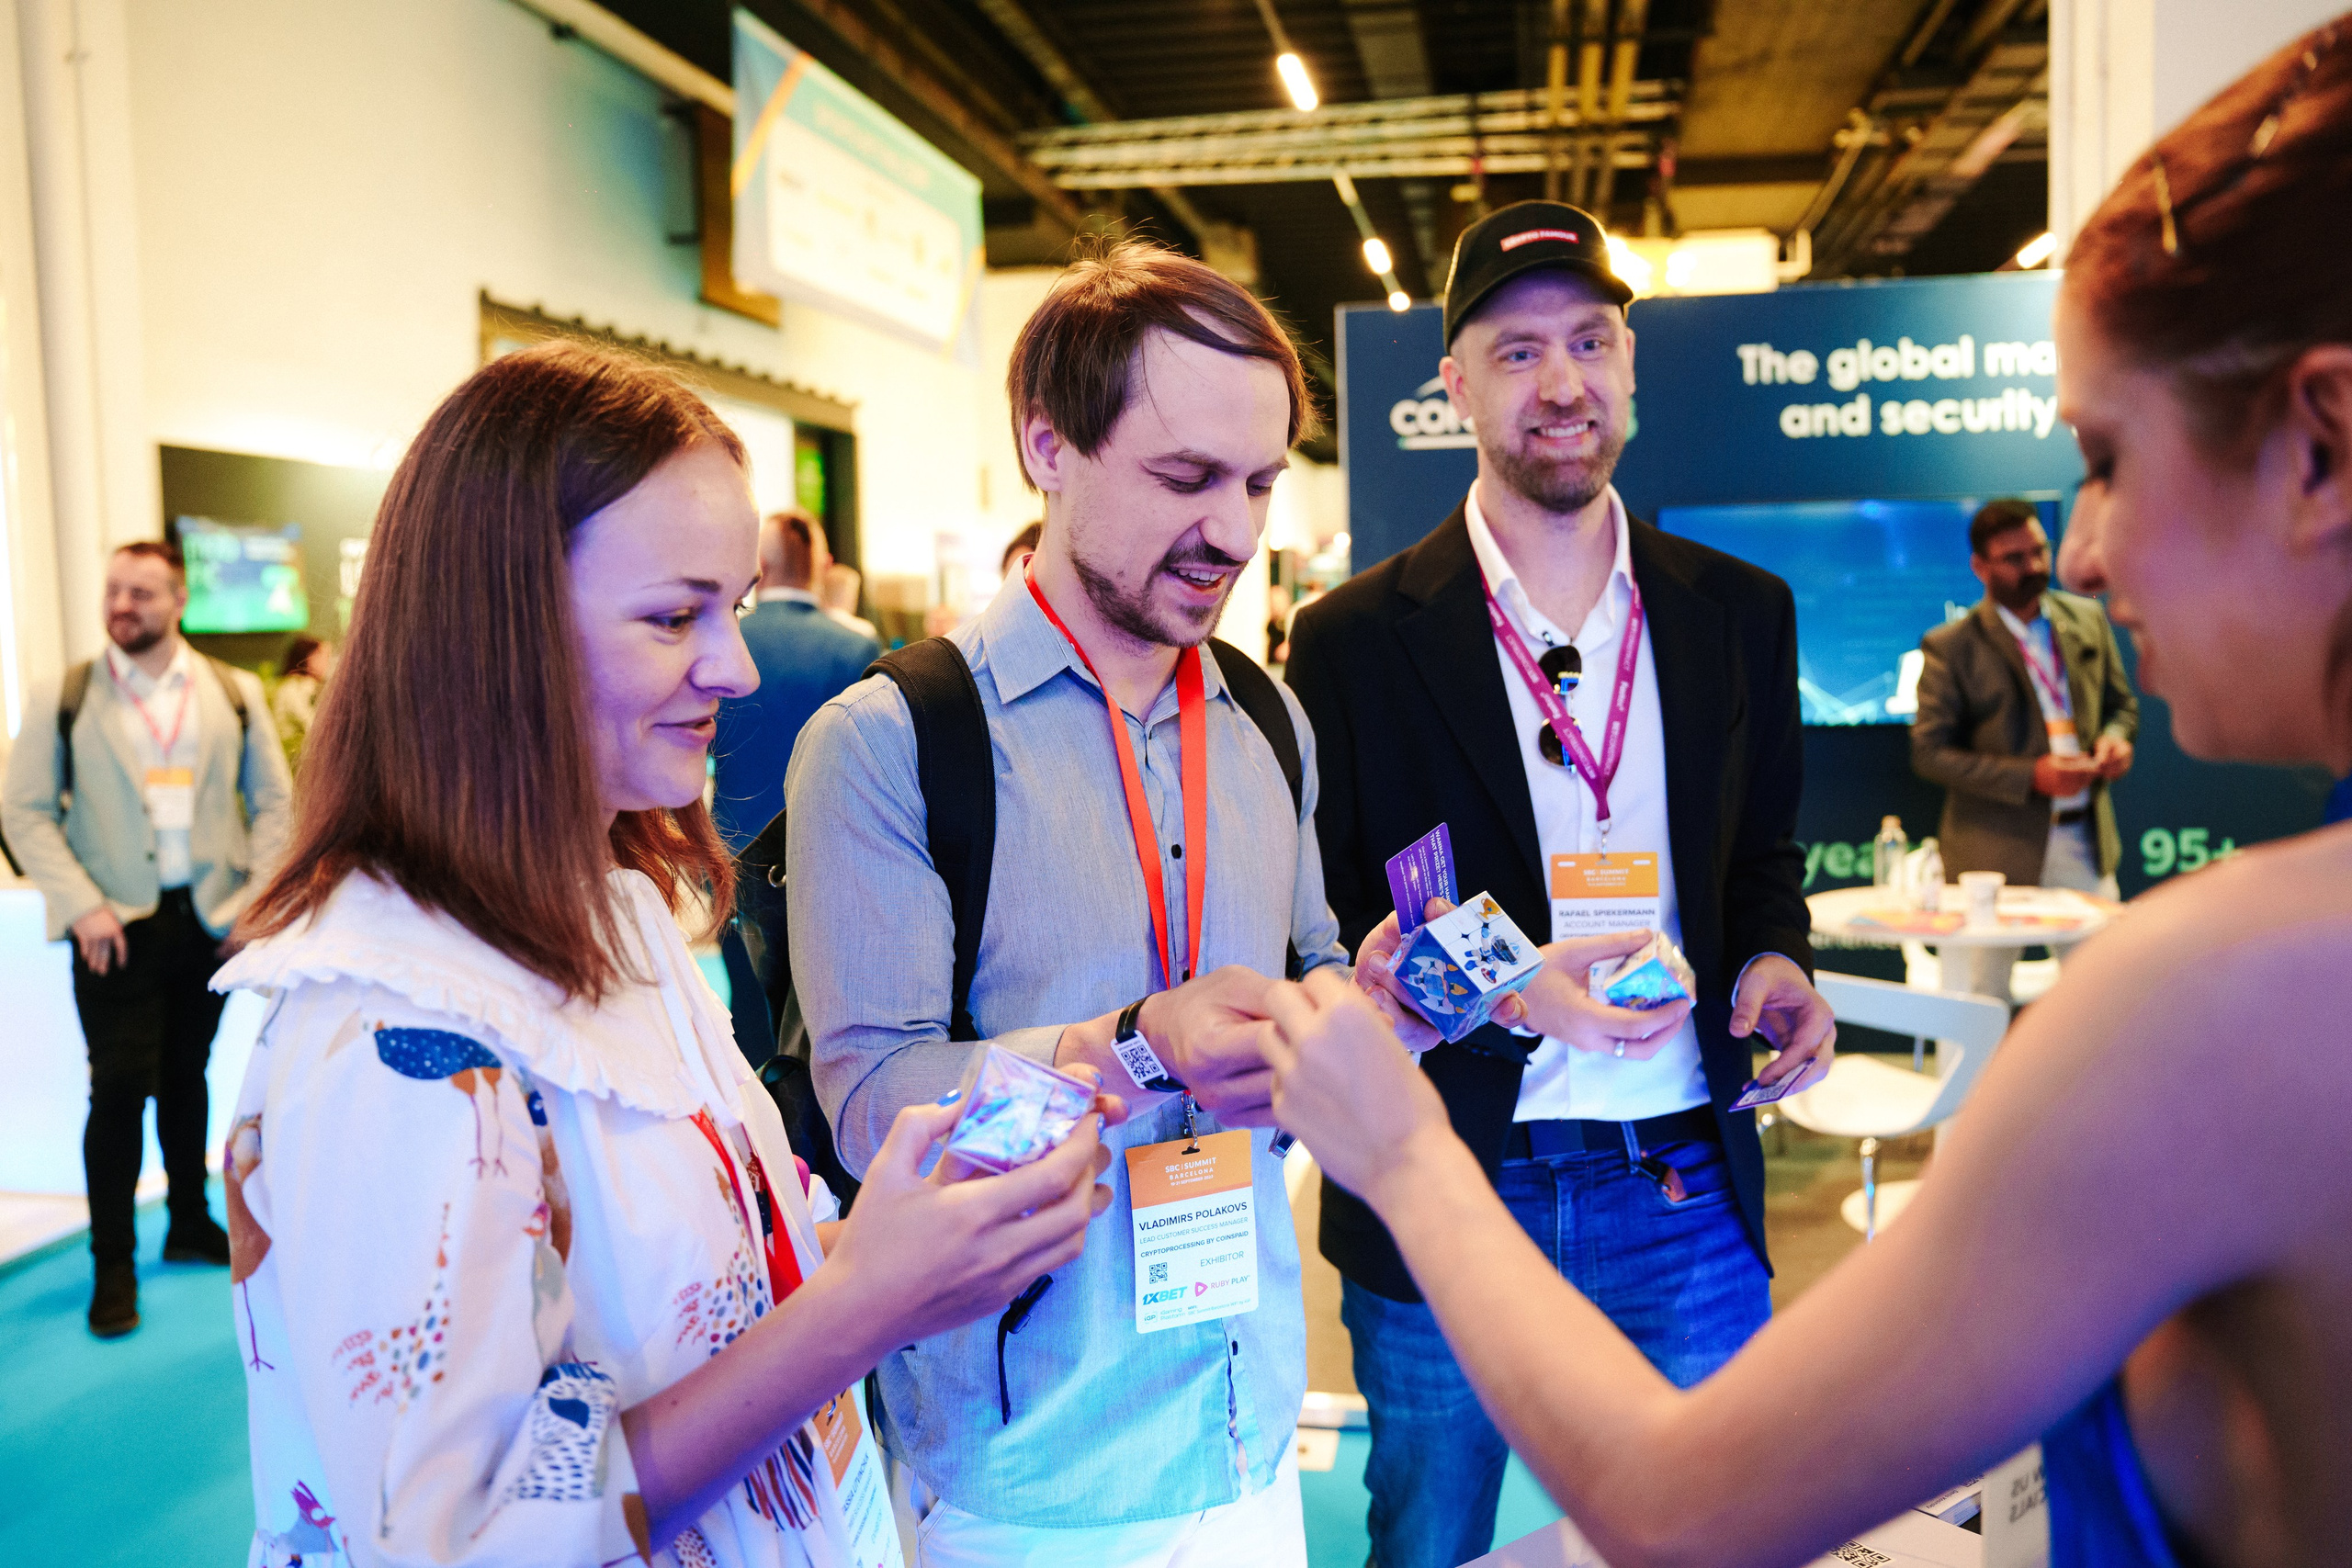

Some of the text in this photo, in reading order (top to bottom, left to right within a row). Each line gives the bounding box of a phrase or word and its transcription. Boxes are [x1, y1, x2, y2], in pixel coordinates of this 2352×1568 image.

[1736, 334, 2057, 391] The global ma
[1780, 387, 2058, 439] and security
[1165, 1156, 1216, 1173] SBC SUMMIT
[1170, 1168, 1214, 1180] BARCELONA
[1138, 1201, 1248, 1231] VLADIMIRS POLAKOVS
[1139, 1216, 1249, 1245] LEAD CUSTOMER SUCCESS MANAGER
[1140, 1240, 1205, 1258] CRYPTOPROCESSING
[1216, 1230, 1250, 1243] COINSPAID
[1200, 1251, 1244, 1268] EXHIBITOR
[1210, 1276, 1249, 1290] RUBY PLAY
[1142, 1286, 1188, 1305] 1XBET
